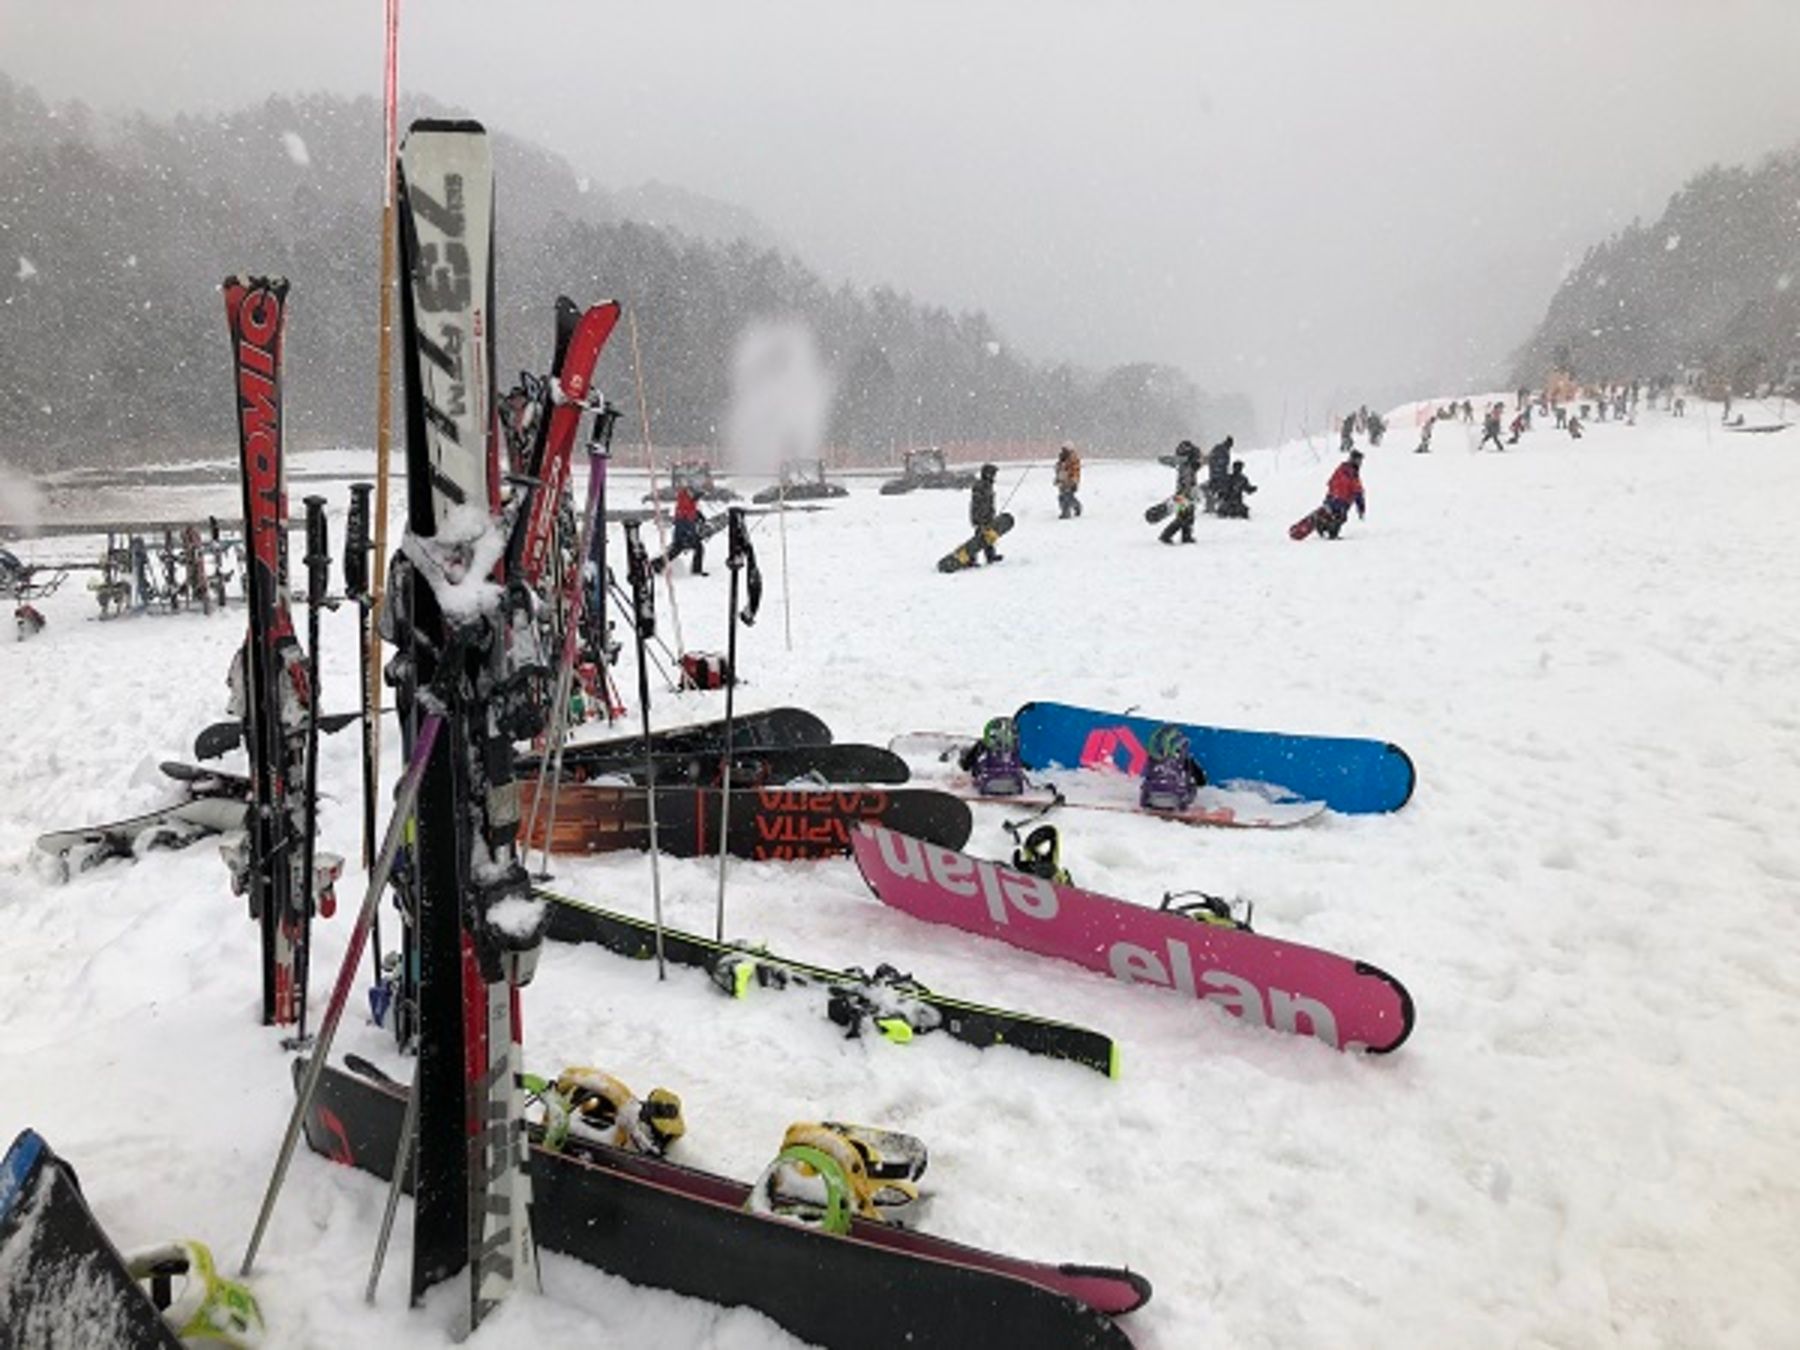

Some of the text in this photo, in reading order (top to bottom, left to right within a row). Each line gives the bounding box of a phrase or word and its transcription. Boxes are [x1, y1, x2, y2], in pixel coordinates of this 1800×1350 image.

[239, 287, 279, 575] ATOMIC
[875, 828, 1060, 925] elan
[1108, 937, 1339, 1052] elan
